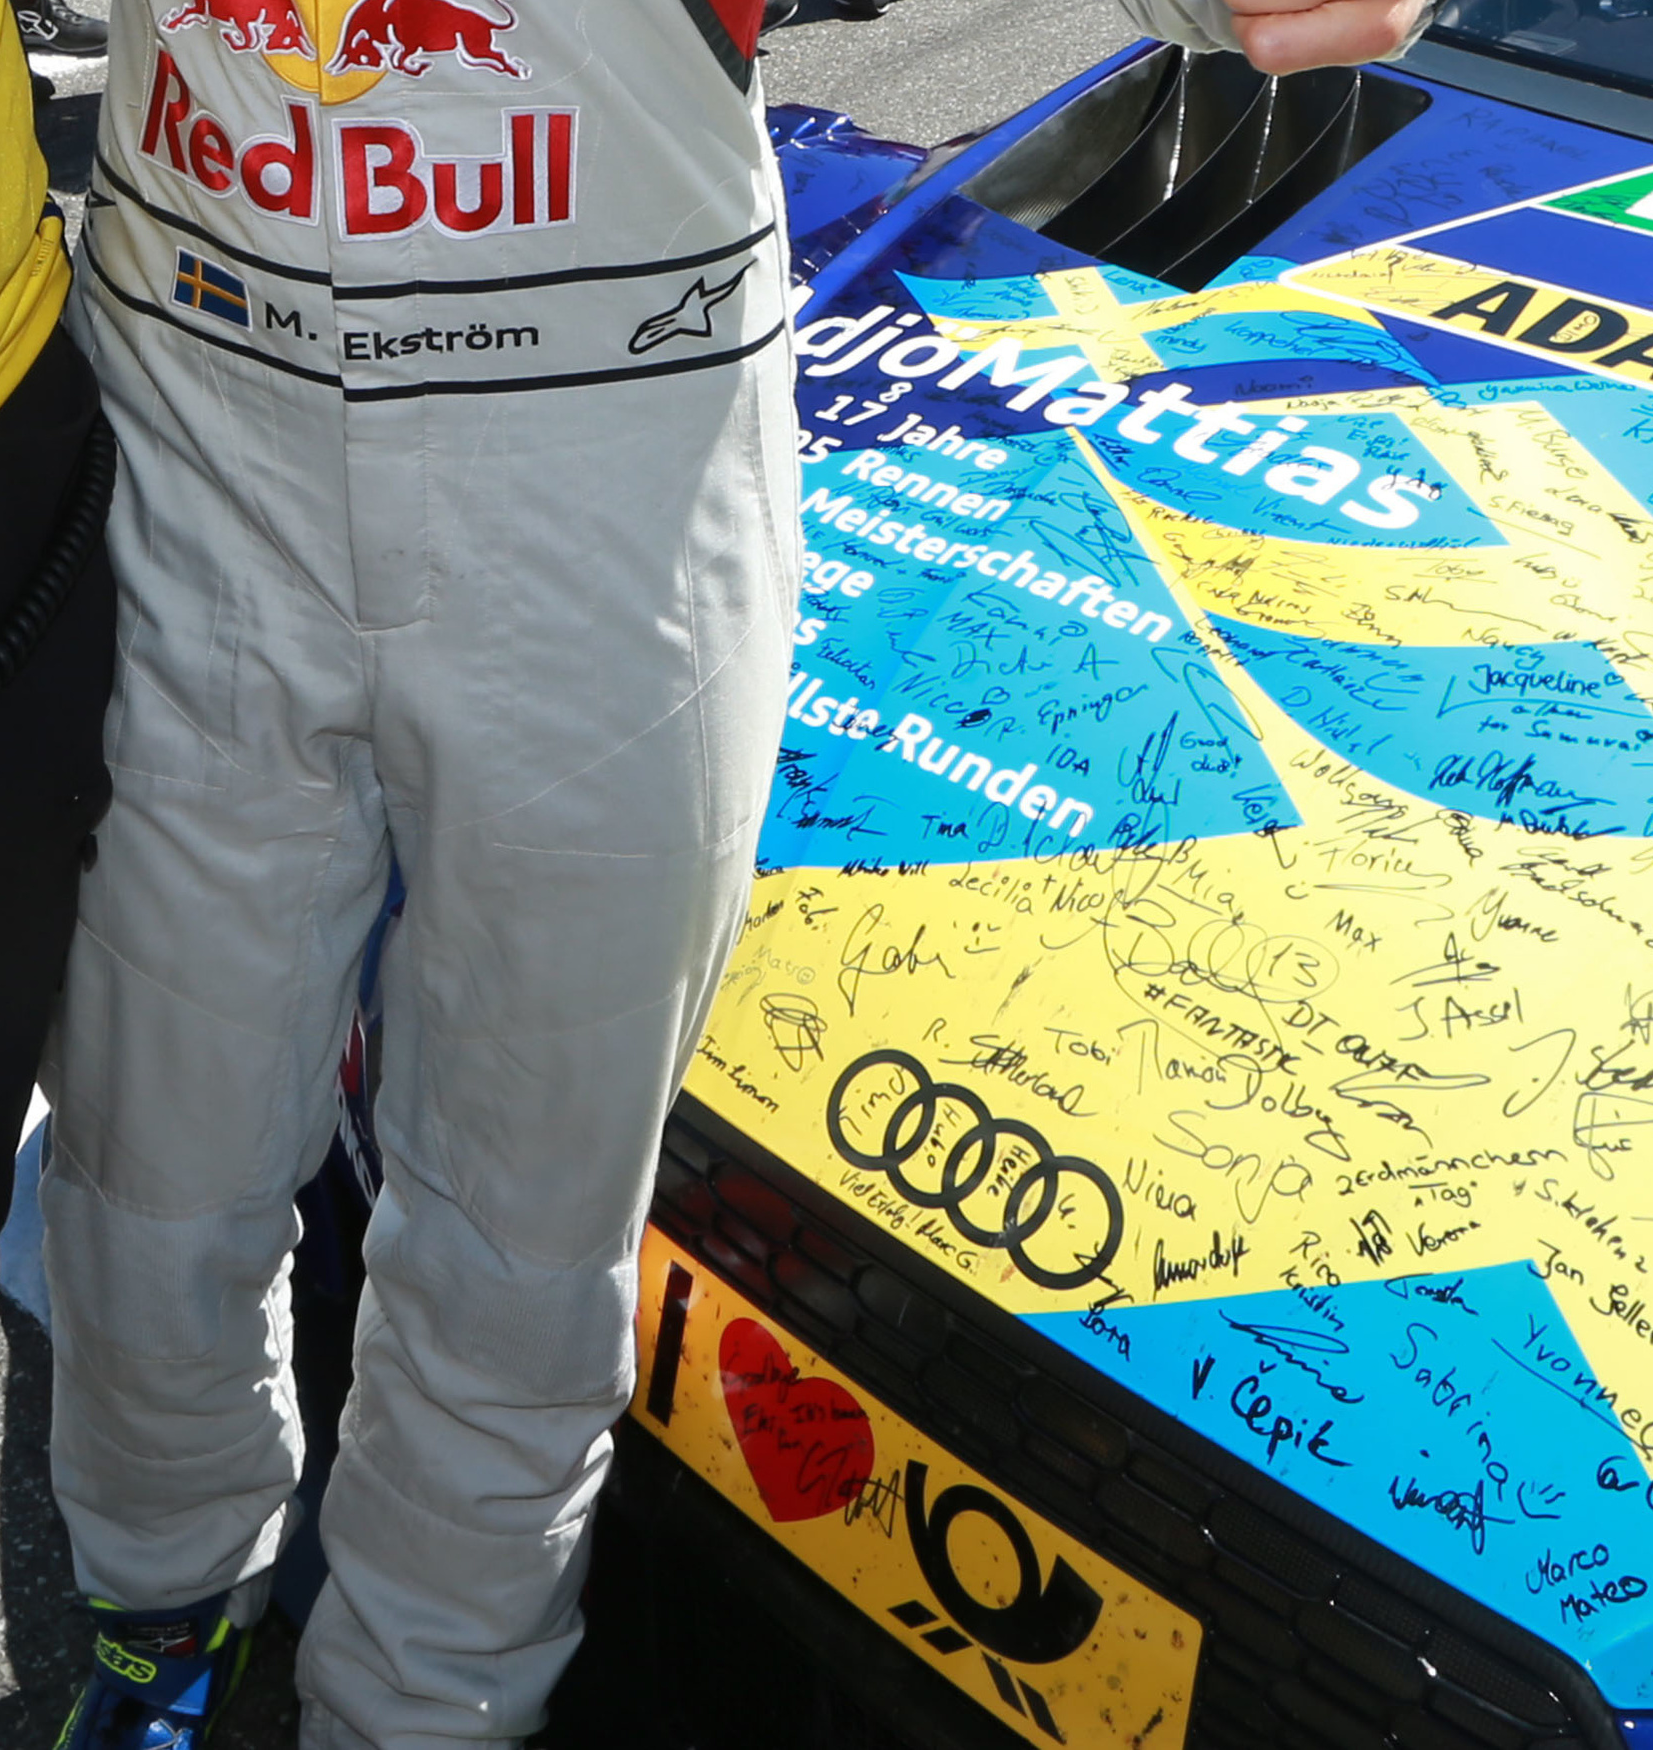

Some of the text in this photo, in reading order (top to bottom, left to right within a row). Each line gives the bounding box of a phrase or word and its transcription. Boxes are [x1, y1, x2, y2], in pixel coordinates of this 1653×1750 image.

[140, 48, 581, 243] Red Bull
[264, 301, 540, 363] M. Ekström
[877, 413, 1009, 472] Jahre
[841, 449, 1012, 523] Rennen
[798, 487, 1173, 644] Meisterschaften
[1472, 663, 1604, 699] Jacqueline
[884, 712, 1094, 838] Runden
